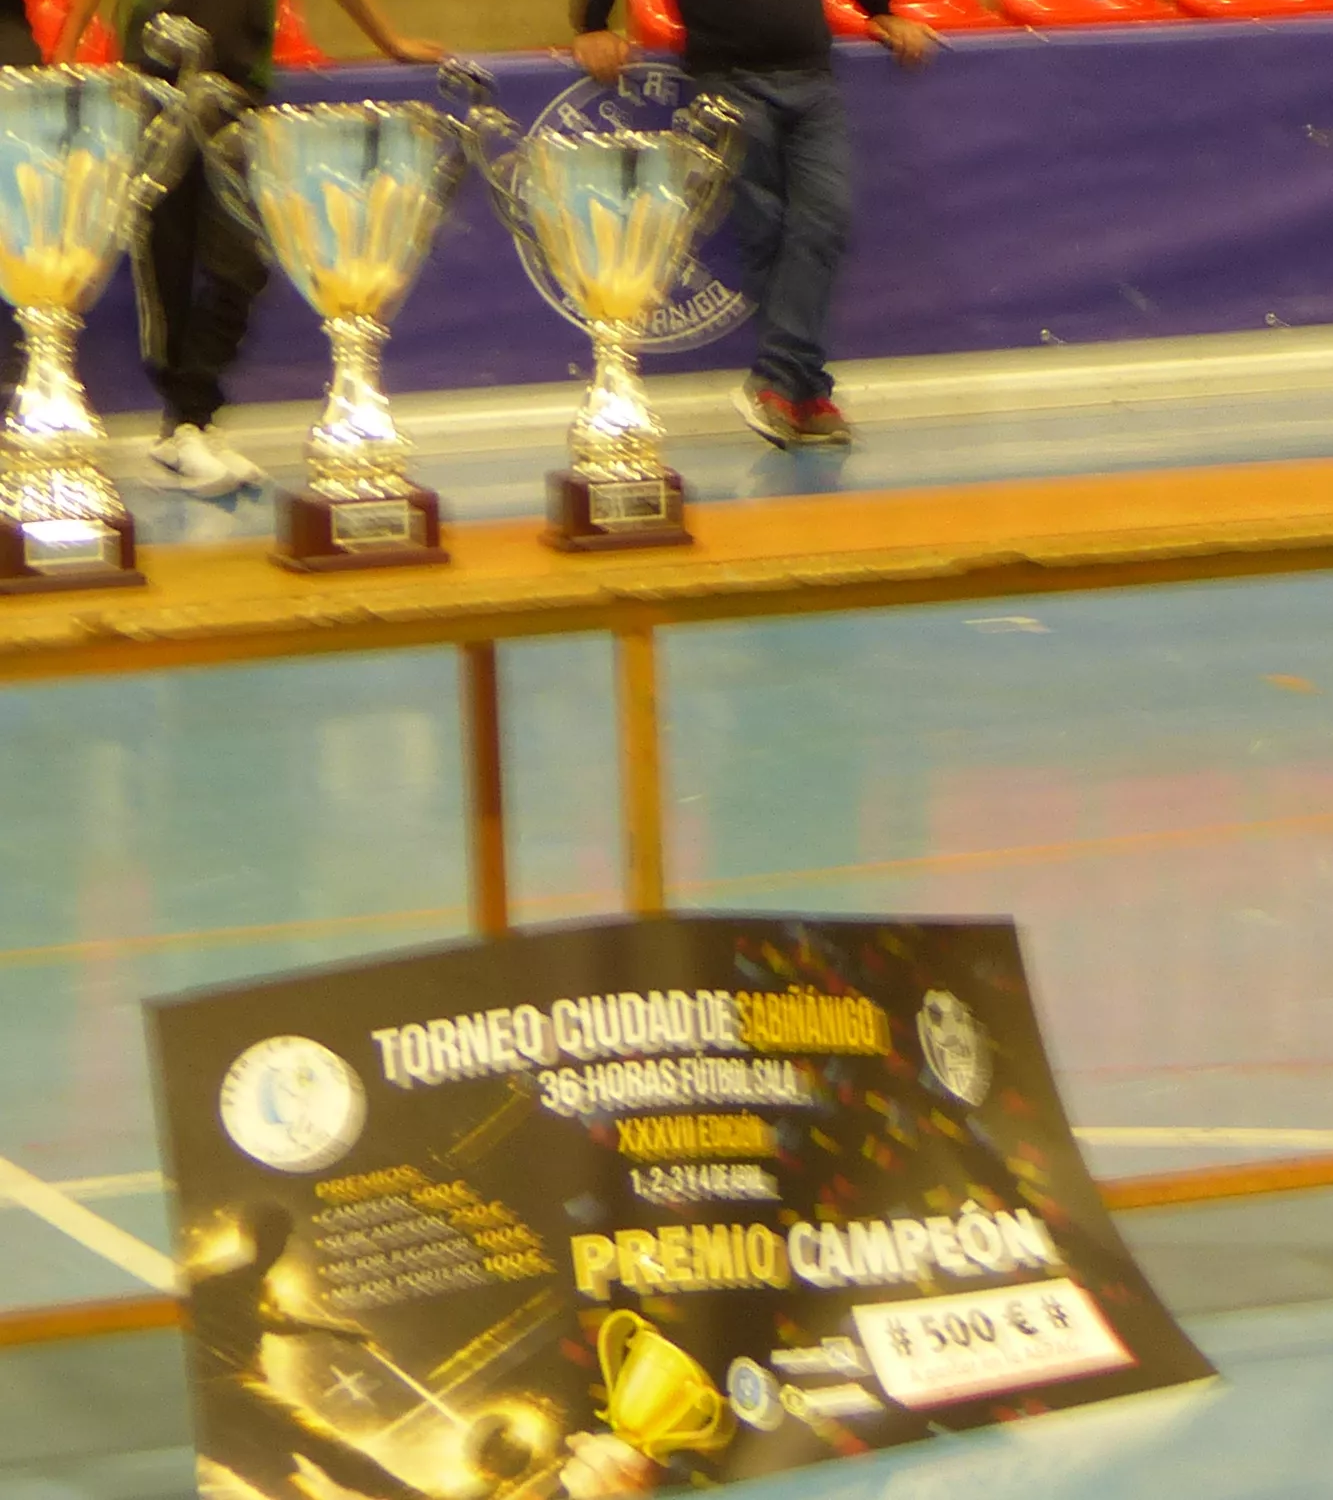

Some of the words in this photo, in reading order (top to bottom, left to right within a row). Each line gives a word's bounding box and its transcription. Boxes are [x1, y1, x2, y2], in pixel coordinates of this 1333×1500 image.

[372, 1003, 548, 1086] TORNEO
[551, 991, 700, 1060] CIUDAD
[695, 990, 741, 1048] DE
[538, 1068, 588, 1114] 36
[583, 1057, 684, 1105] HORAS
[571, 1222, 780, 1297] PREMIO
[788, 1199, 1058, 1286] CAMPEÓN
[919, 1308, 995, 1353] 500
